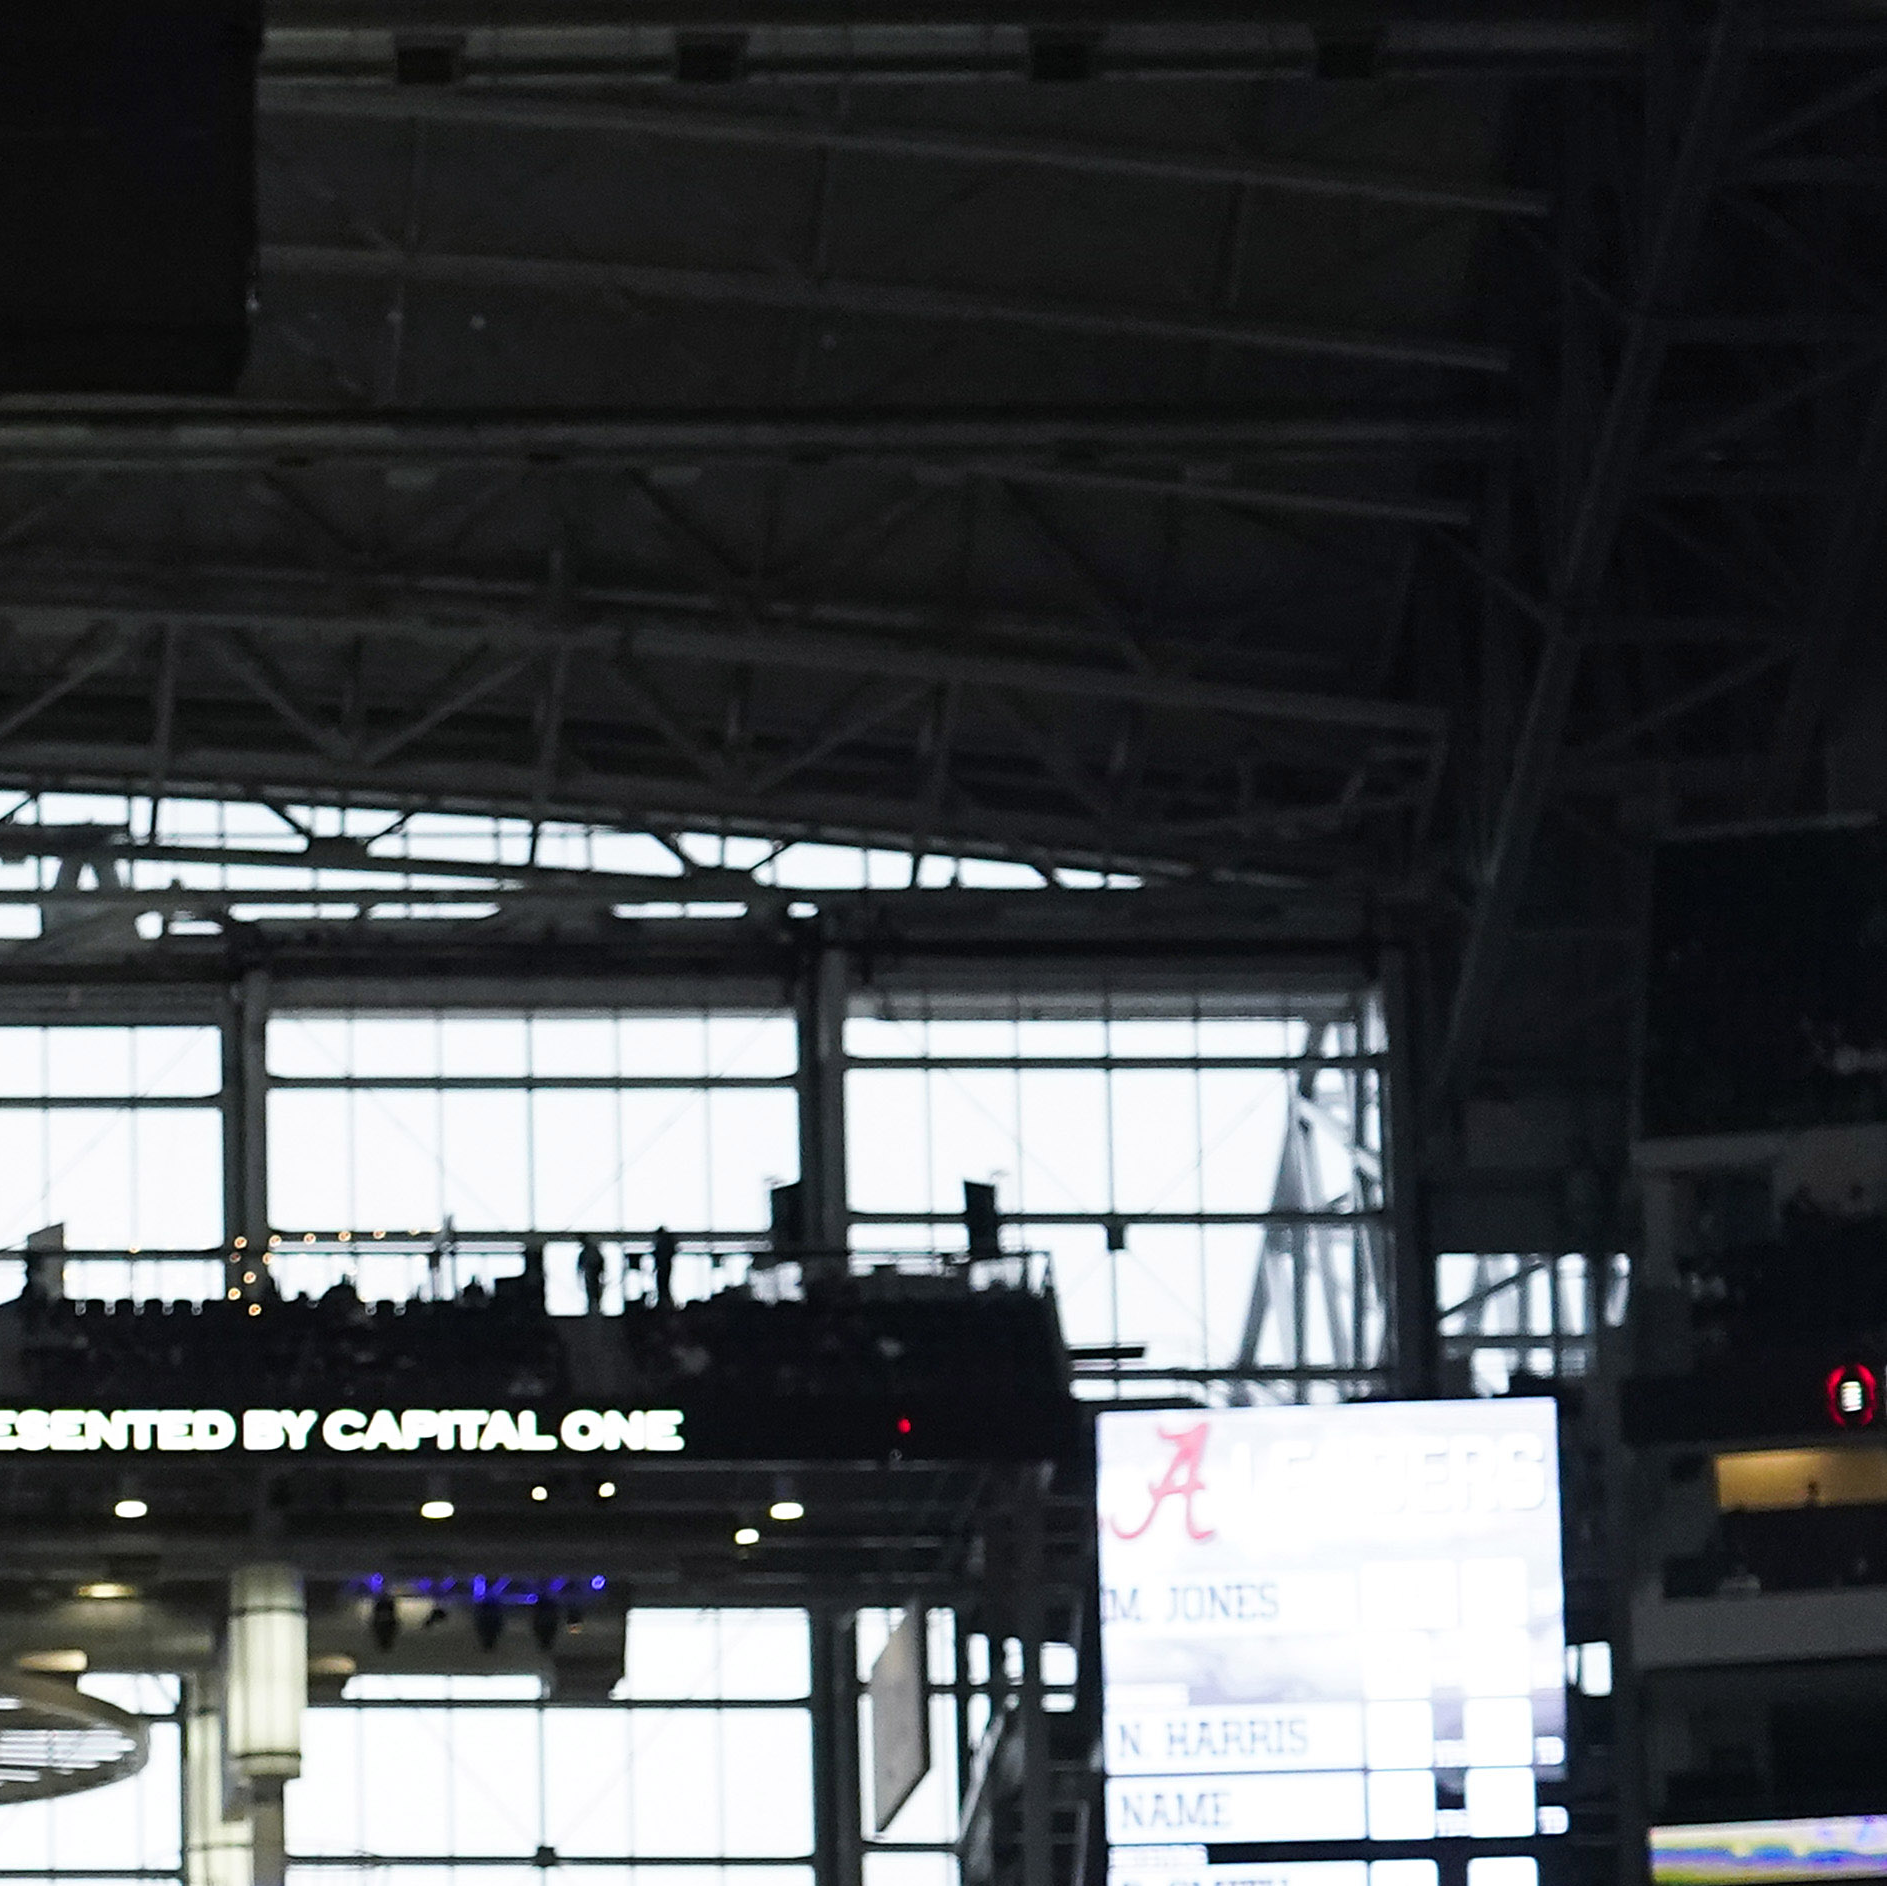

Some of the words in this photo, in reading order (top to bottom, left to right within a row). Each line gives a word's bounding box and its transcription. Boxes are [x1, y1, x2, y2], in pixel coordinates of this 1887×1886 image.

[243, 1408, 317, 1451] BY
[323, 1408, 558, 1451] CAPITAL
[561, 1408, 683, 1451] ONE
[1164, 1582, 1279, 1622] JONES
[1118, 1721, 1152, 1760] N.
[1167, 1717, 1309, 1758] HARRIS
[1121, 1791, 1233, 1831] NAME
